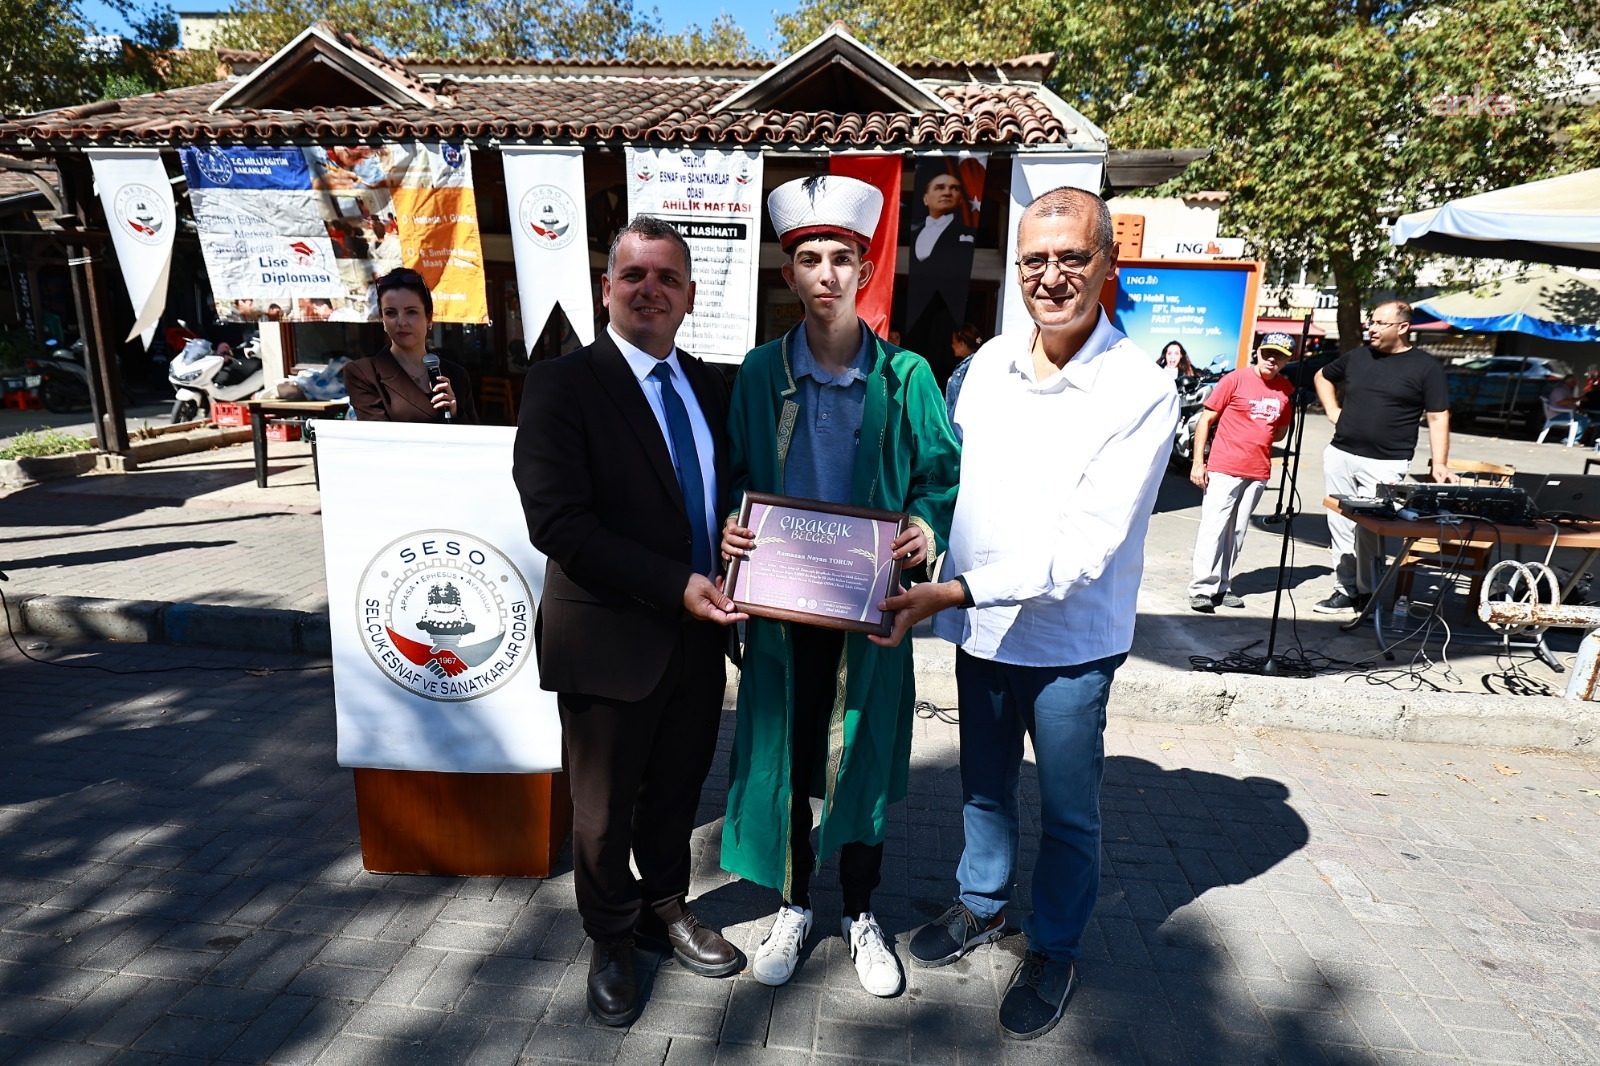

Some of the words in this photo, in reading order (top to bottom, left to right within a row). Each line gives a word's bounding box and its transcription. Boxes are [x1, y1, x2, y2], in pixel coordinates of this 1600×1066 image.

[234, 166, 272, 175] BAKANLIĞI
[660, 172, 678, 182] ESNAF
[688, 173, 730, 184] SANATKARLAR
[686, 188, 704, 198] ODASI
[662, 199, 700, 210] AHİLİK
[705, 202, 751, 212] HAFTASI
[691, 225, 737, 237] NASİHATI
[1176, 243, 1202, 254] ING
[259, 257, 288, 268] Lise
[262, 272, 330, 285] Diploması
[1126, 276, 1146, 284] ING
[1128, 293, 1142, 302] ING
[1143, 294, 1164, 302] Mobil
[1166, 296, 1180, 304] var,
[1152, 305, 1169, 314] EFT,
[1170, 305, 1195, 314] havale
[1151, 315, 1172, 323] FAST
[1205, 327, 1222, 336] yok.
[780, 516, 852, 538] ÇIRAKLIK
[400, 541, 485, 565] SESO
[776, 550, 806, 559] Ramazan
[807, 555, 827, 563] Noyan
[829, 558, 854, 566] TORUN
[400, 584, 416, 611] APASA
[420, 572, 458, 583] EPHESUS
[466, 578, 492, 614] AYASULUK
[366, 598, 389, 653] SELÇUK
[381, 650, 422, 684] ESNAF
[422, 678, 438, 694] VE
[440, 642, 522, 695] SANATKARLAR
[511, 600, 527, 641] ODASI
[439, 657, 457, 665] 1967
